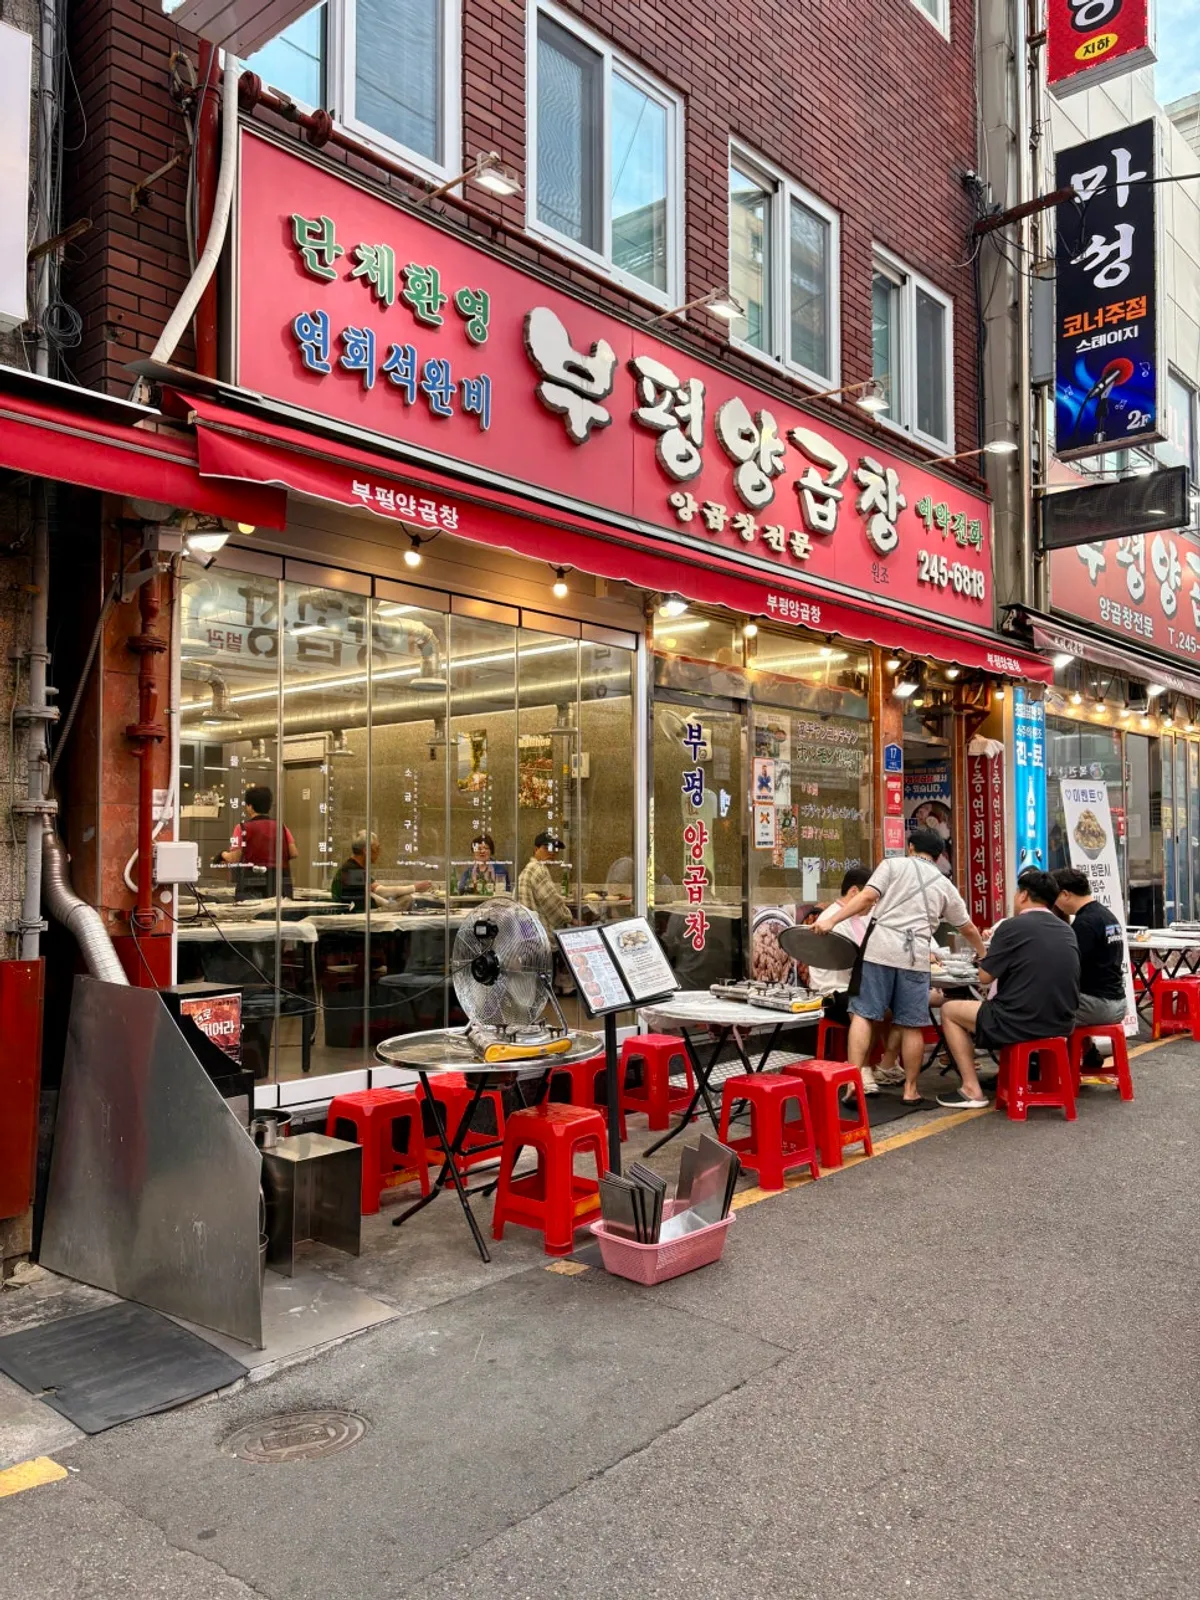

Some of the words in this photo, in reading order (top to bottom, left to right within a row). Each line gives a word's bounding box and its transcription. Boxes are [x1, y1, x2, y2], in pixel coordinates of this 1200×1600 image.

[1083, 37, 1111, 57] 지하
[1070, 148, 1148, 288] 마성
[289, 214, 490, 344] 단체환영
[1062, 296, 1147, 338] 코너주점
[1076, 325, 1139, 353] 스테이지
[292, 310, 491, 431] 연회석완비
[523, 306, 906, 555] 부평양곱창
[1127, 410, 1151, 430] 2F
[351, 480, 459, 529] 부평양곱창
[668, 491, 813, 560] 양곱창전문
[915, 496, 983, 552] 예약전화
[872, 562, 890, 584] 원조
[917, 549, 985, 600] 245-6818
[767, 593, 822, 623] 부평양곱창
[1100, 597, 1154, 638] 양곱창전문
[404, 768, 412, 853] 소금구이
[1073, 788, 1097, 803] 이벤트
[682, 722, 710, 951] 부평양곱창
[1091, 863, 1111, 877] 방문시
